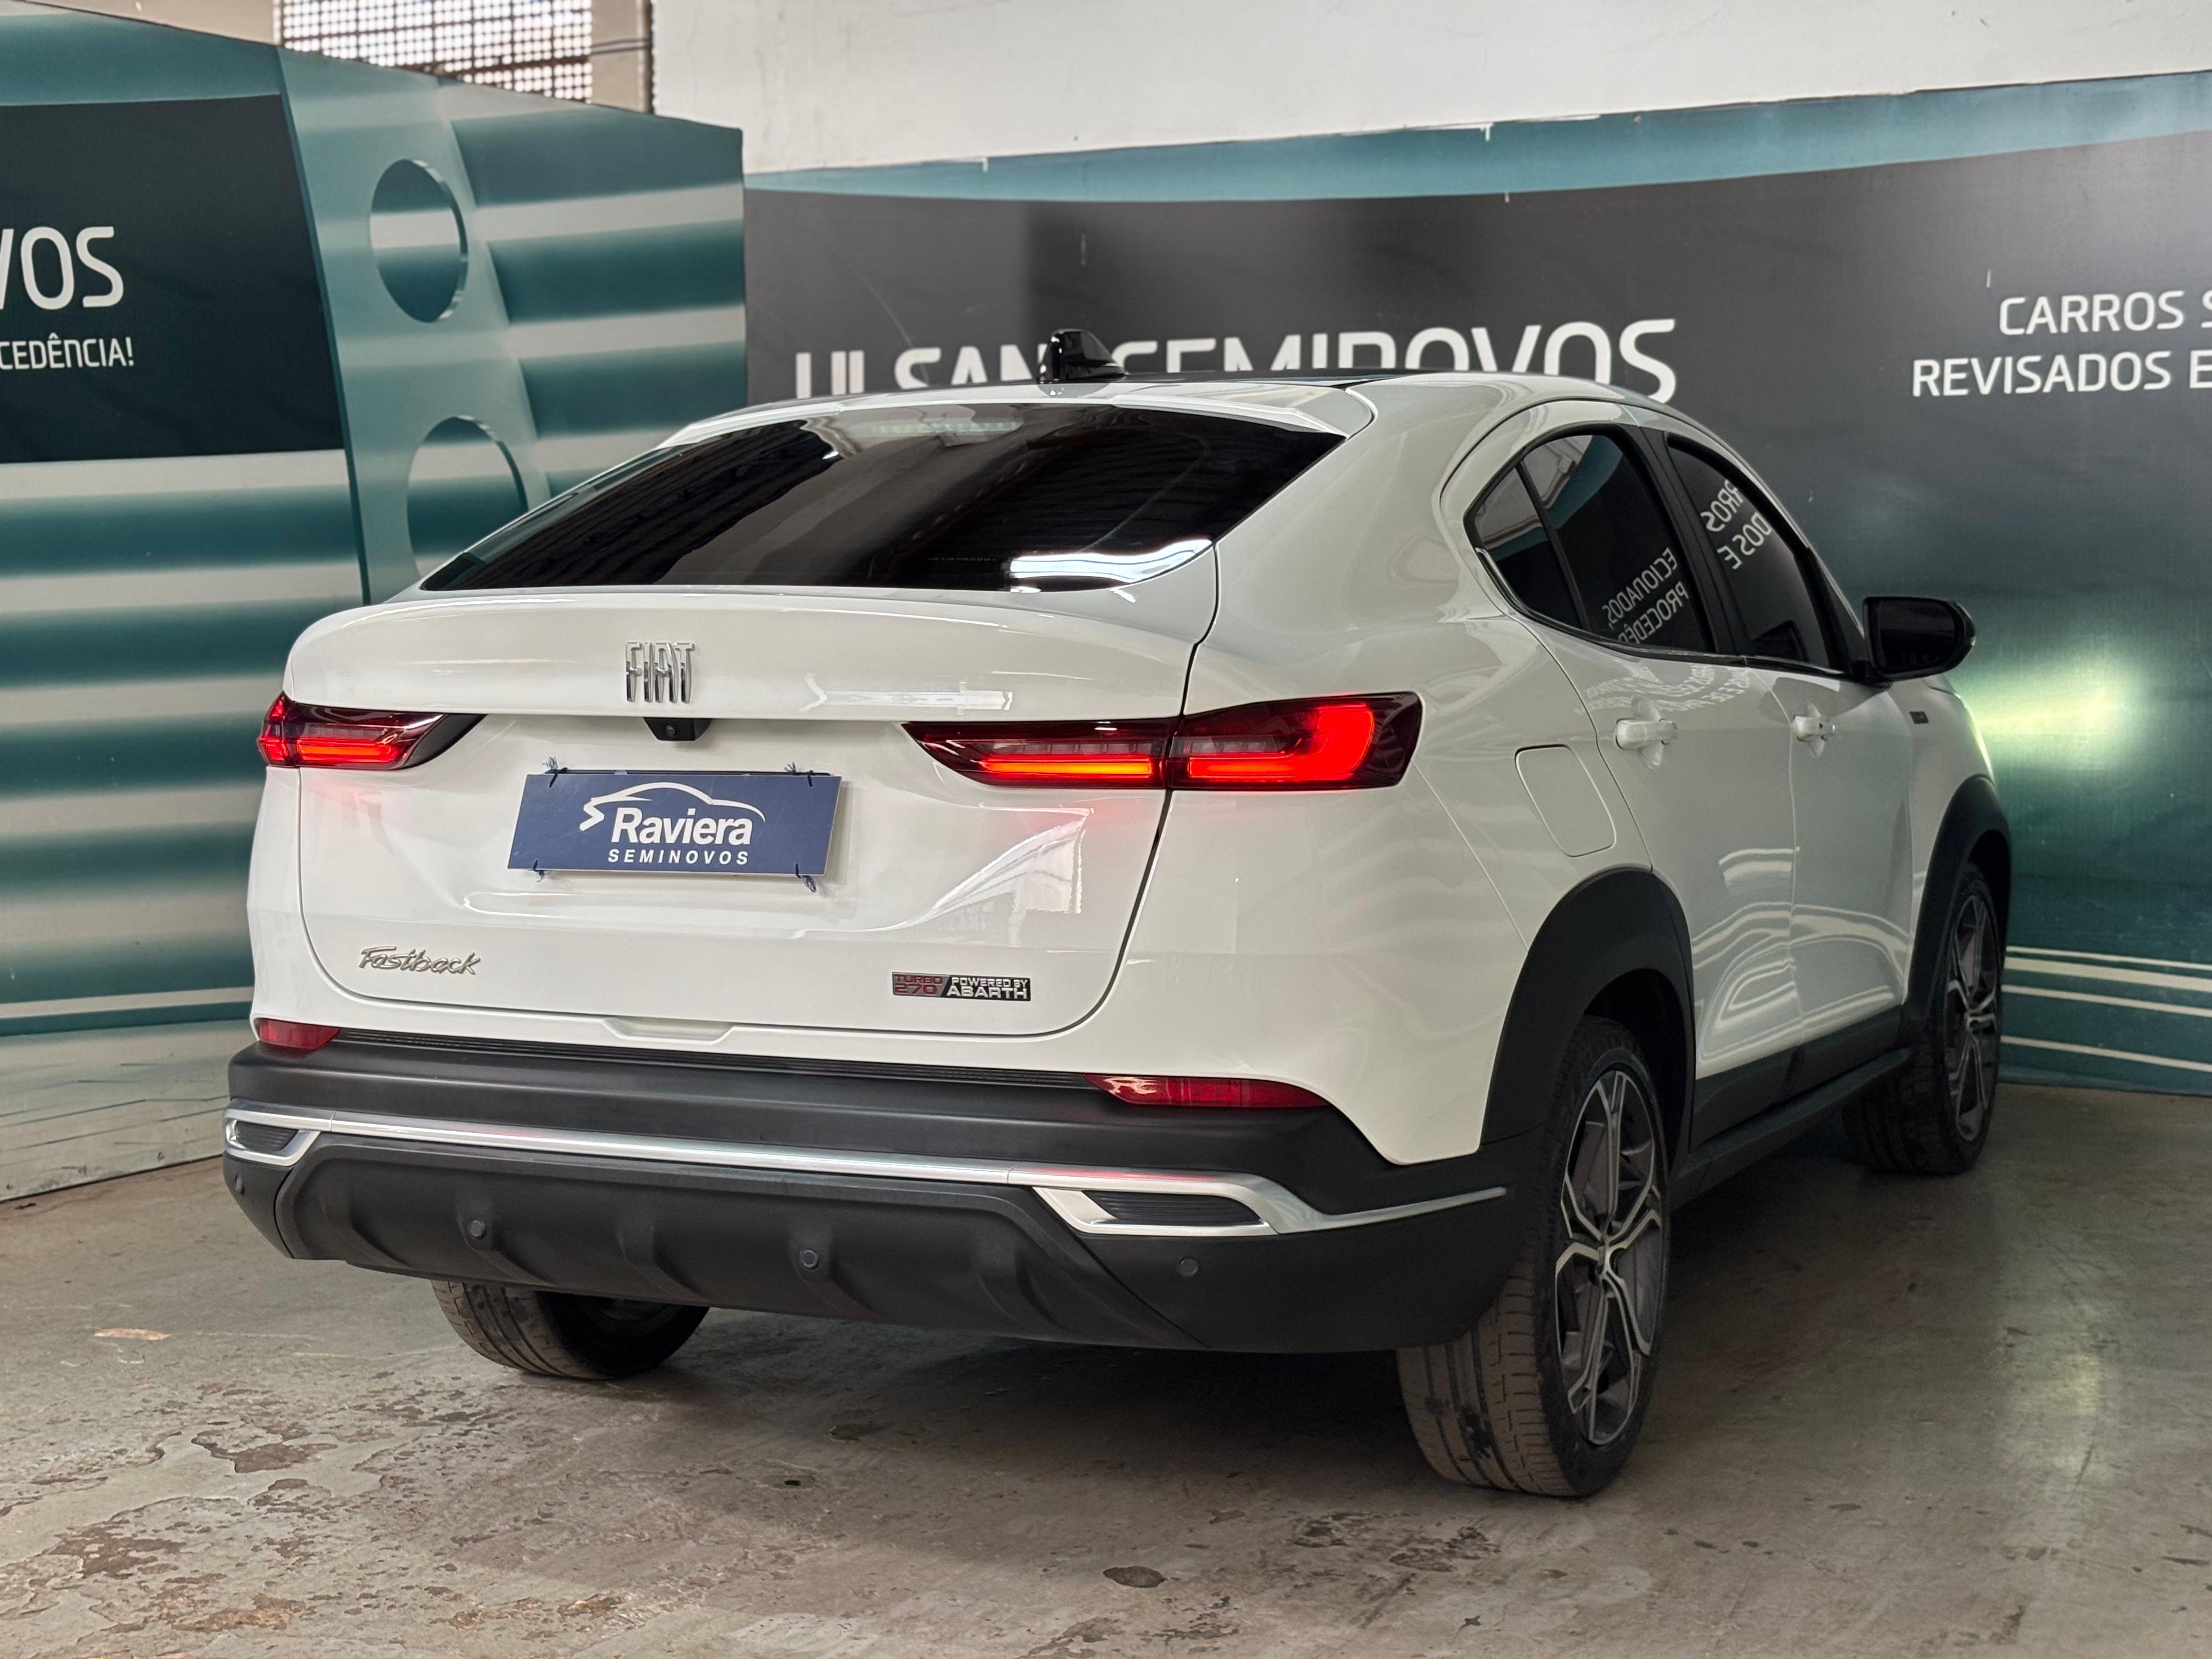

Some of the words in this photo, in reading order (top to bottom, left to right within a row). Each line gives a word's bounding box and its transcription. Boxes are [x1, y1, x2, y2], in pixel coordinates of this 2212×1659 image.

[2000, 290, 2185, 335] CARROS
[0, 332, 134, 370] CEDÊNCIA!
[1912, 351, 2172, 397] REVISADOS
[2190, 349, 2212, 389] E
[624, 641, 695, 703] FIAT
[611, 807, 753, 845] Raviera
[608, 848, 749, 865] SEMINOVOS
[359, 945, 482, 975] Fastback
[894, 974, 943, 984] TURBO
[894, 983, 938, 995] 270
[946, 985, 1028, 1000] ABARTH
[951, 977, 1011, 987] POWERED
[1013, 979, 1028, 988] BY
